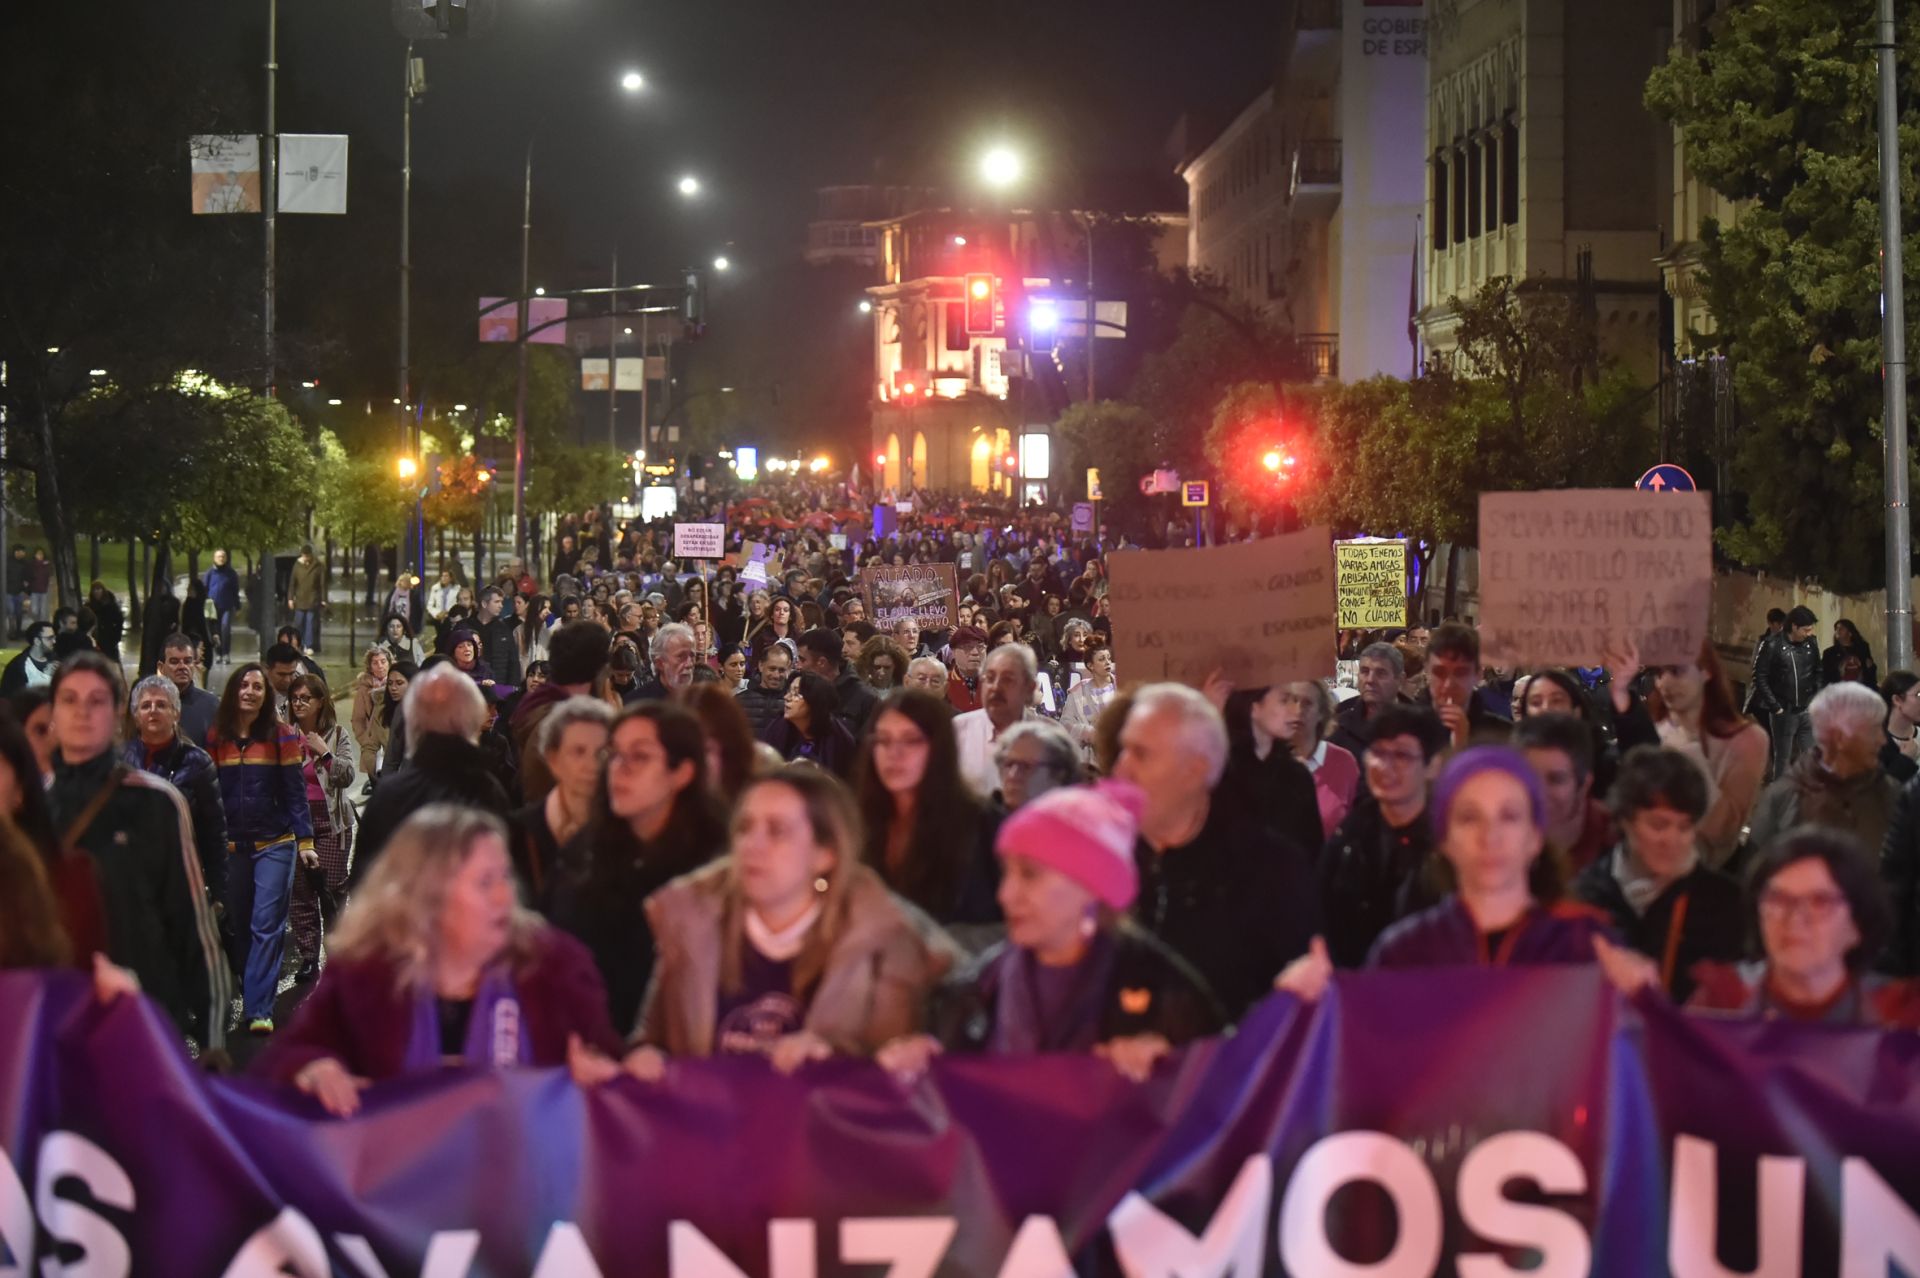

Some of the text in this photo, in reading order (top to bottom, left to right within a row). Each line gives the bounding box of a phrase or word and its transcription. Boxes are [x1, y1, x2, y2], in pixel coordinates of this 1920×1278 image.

[1363, 18, 1426, 34] GOBIE
[1363, 39, 1387, 55] DE
[1623, 508, 1660, 539] NOS
[1664, 507, 1693, 539] DIO
[1340, 547, 1403, 560] TODAS TENEMOS
[1339, 559, 1401, 571] VARIAS AMIGAS
[1488, 548, 1686, 581] EL MARTILLO PARA
[877, 608, 890, 618] EL
[919, 605, 948, 616] LLEVO
[1518, 587, 1658, 626] ROMPER LA
[916, 616, 949, 628] LGADO
